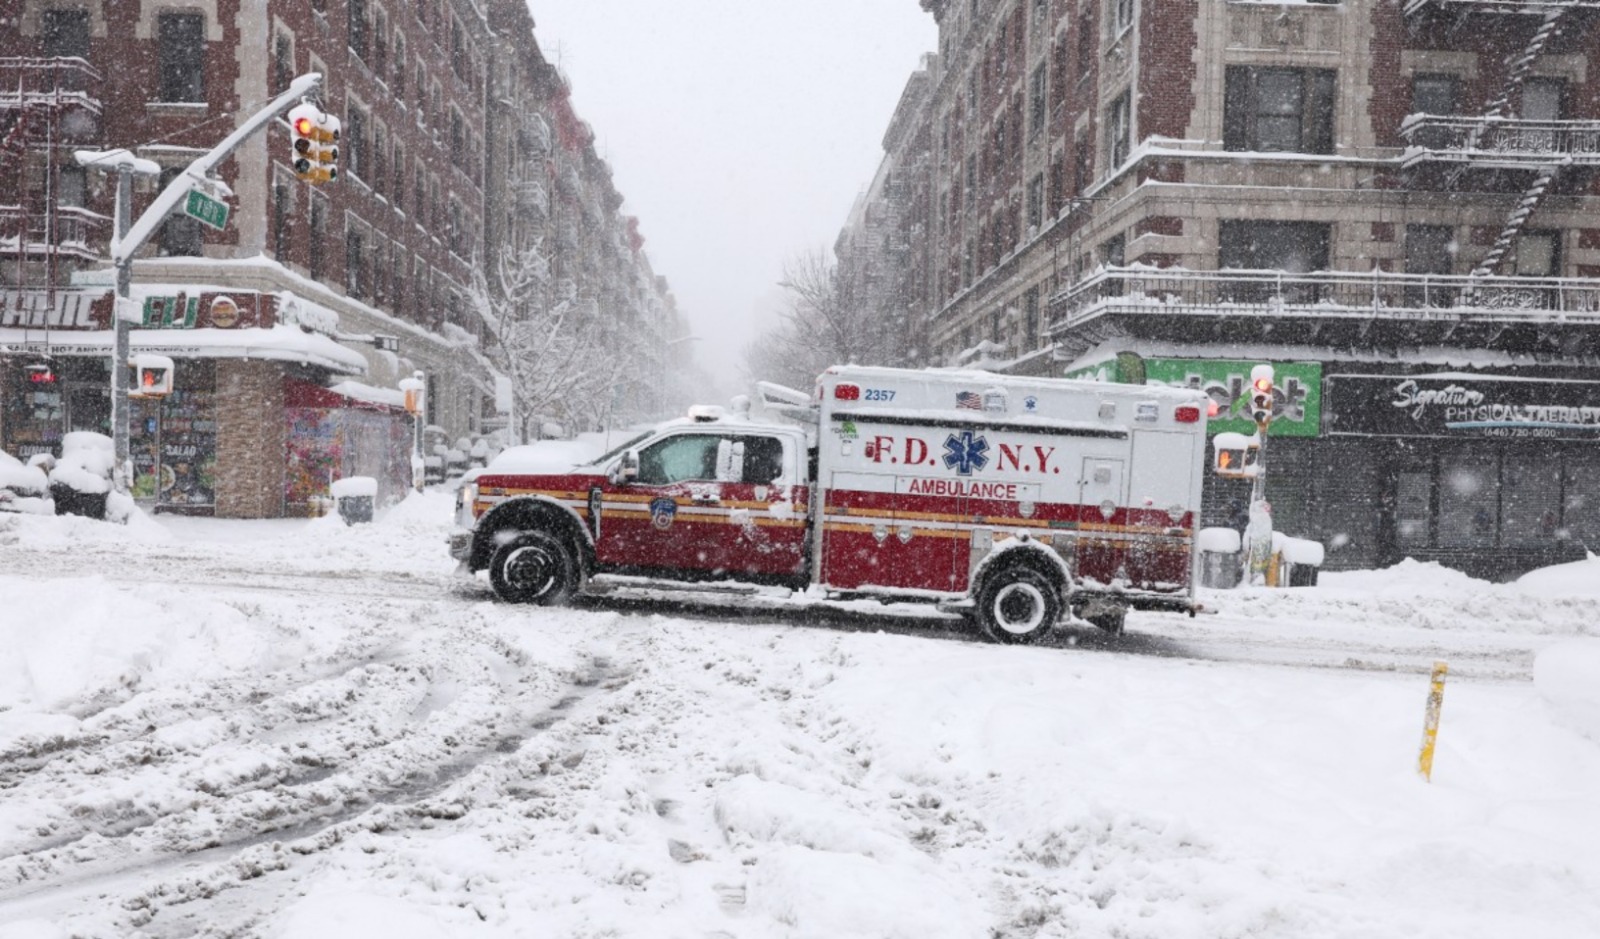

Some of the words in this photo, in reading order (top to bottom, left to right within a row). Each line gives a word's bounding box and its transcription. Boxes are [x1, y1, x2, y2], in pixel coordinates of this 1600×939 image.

[112, 295, 200, 328] ELI
[865, 389, 896, 401] 2357
[1446, 404, 1524, 422] PHYSICAL
[1525, 405, 1600, 423] THERAPY
[1484, 428, 1509, 437] (646)
[165, 444, 197, 457] SALAD
[873, 436, 936, 466] F.D.
[996, 443, 1060, 474] N.Y.
[909, 478, 1017, 499] AMBULANCE
